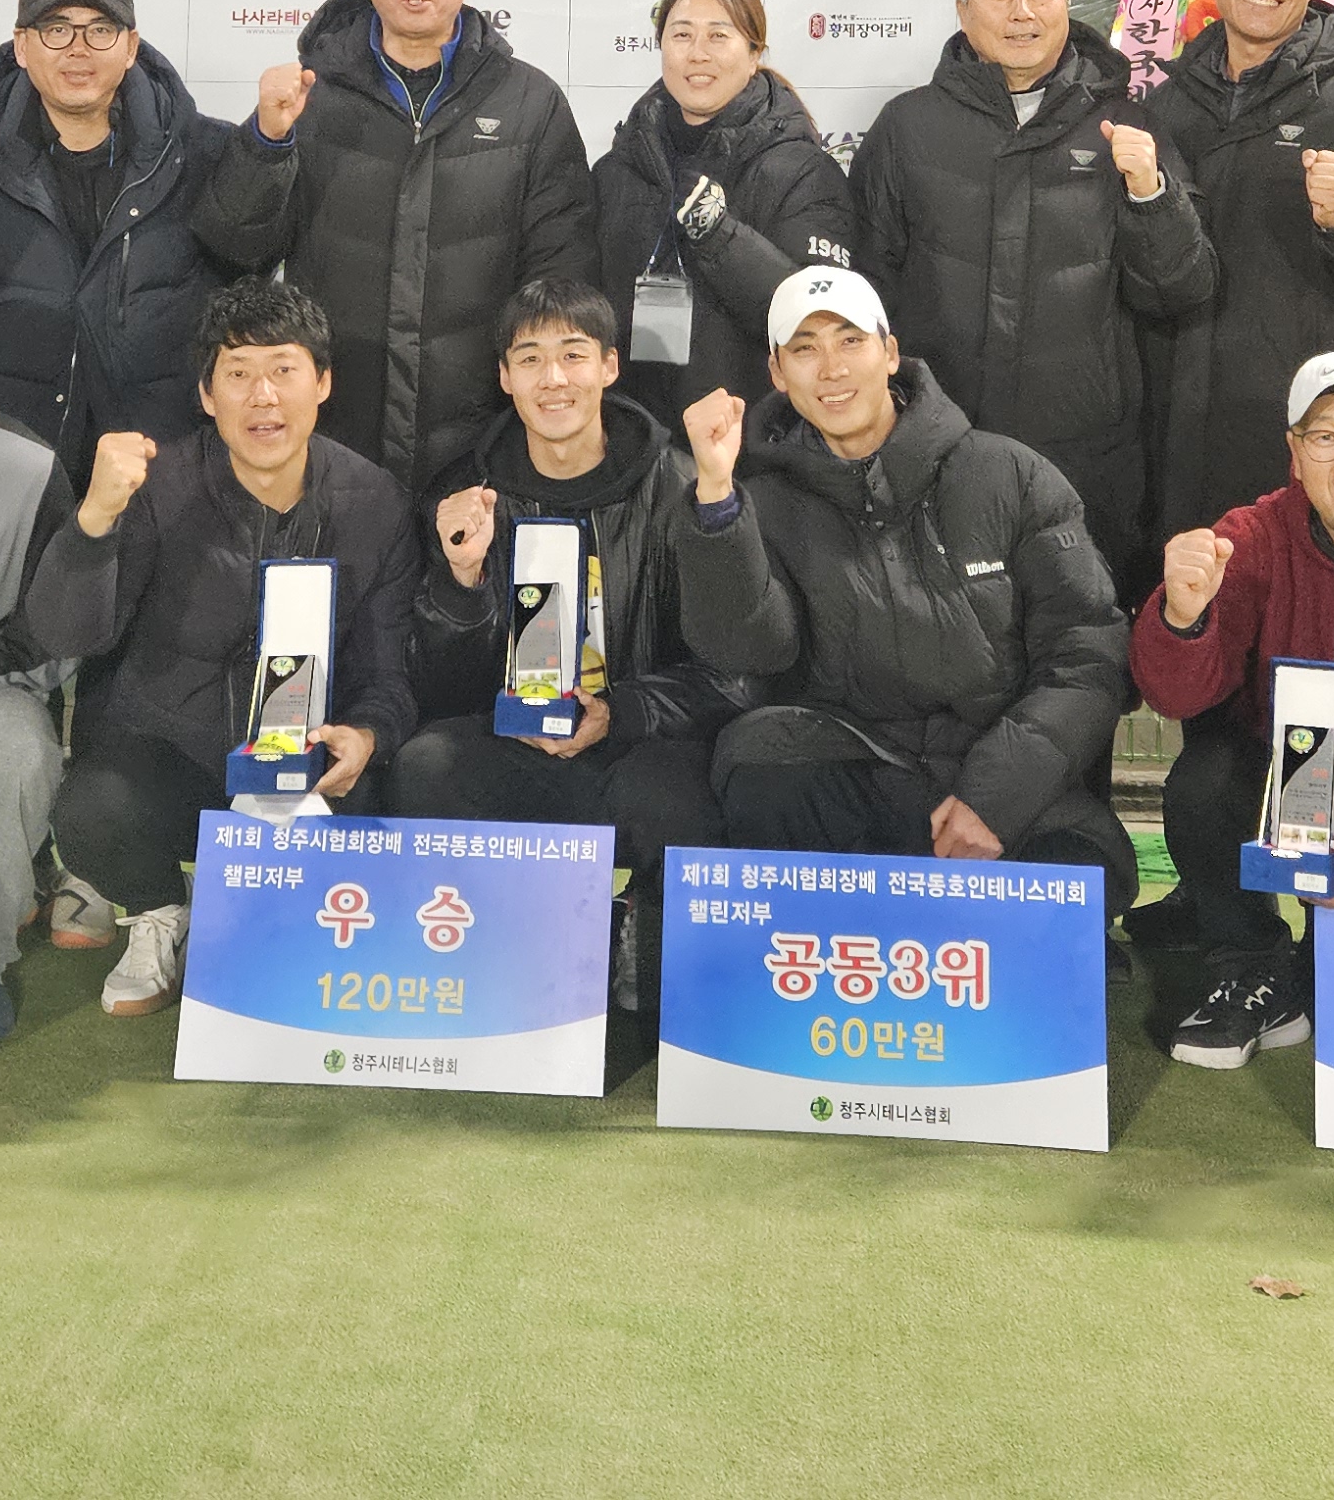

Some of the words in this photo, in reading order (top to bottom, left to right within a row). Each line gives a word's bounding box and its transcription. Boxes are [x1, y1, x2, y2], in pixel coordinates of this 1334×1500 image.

[828, 22, 912, 38] 황제장어갈비
[808, 236, 850, 268] 1945
[966, 561, 1005, 577] Wilson
[214, 825, 261, 850] 제1회
[272, 826, 402, 856] 청주시협회장배
[413, 832, 599, 863] 전국동호인테니스대회
[223, 863, 304, 889] 챌린저부
[681, 862, 729, 888] 제1회
[741, 864, 876, 895] 청주시협회장배
[888, 872, 1086, 905] 전국동호인테니스대회
[316, 882, 375, 949] 우
[416, 885, 474, 953] 승
[688, 899, 772, 926] 챌린저부
[765, 932, 989, 1010] 공동3위
[316, 972, 464, 1015] 120만원
[810, 1015, 944, 1062] 60만원
[351, 1053, 458, 1075] 청주시테니스협회
[839, 1100, 951, 1125] 청주시테니스협회
